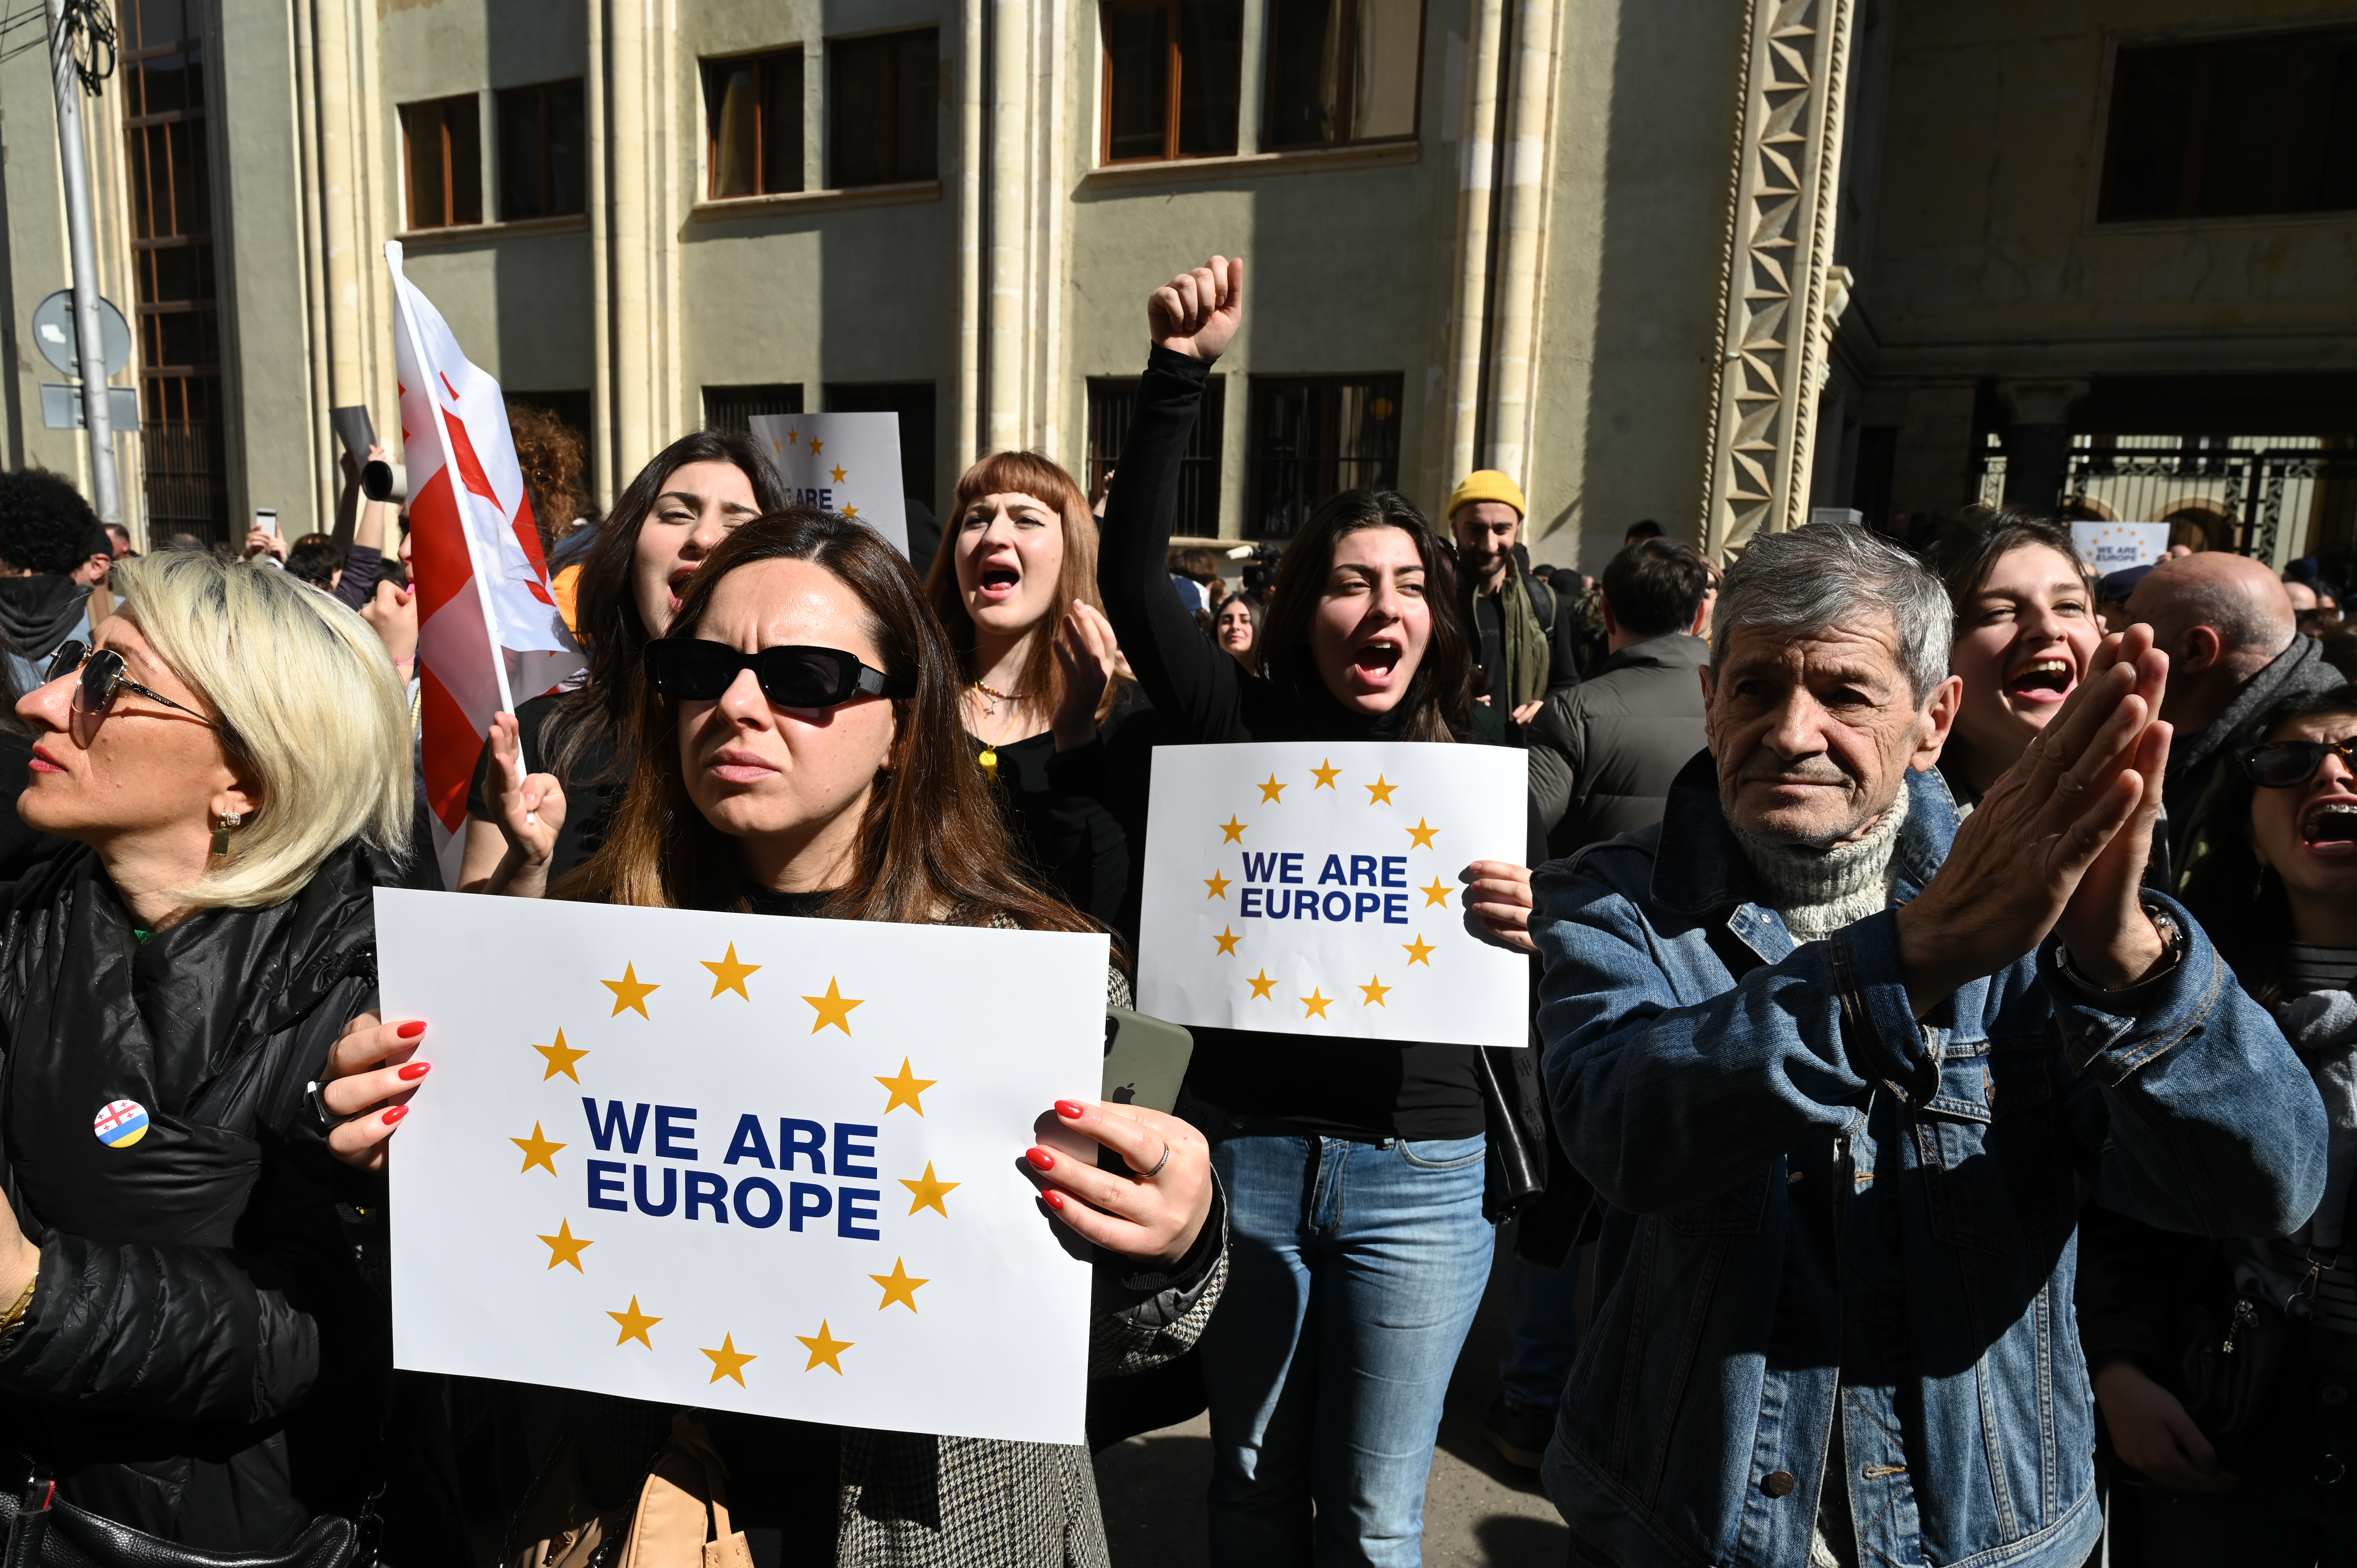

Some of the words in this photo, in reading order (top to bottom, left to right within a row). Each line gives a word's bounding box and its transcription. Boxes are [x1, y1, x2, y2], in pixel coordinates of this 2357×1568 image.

[797, 488, 832, 509] ARE
[1242, 852, 1304, 884] WE
[1317, 854, 1407, 888] ARE
[1240, 888, 1408, 924] EUROPE
[581, 1097, 698, 1161] WE
[723, 1113, 878, 1180] ARE
[587, 1159, 880, 1241] EUROPE
